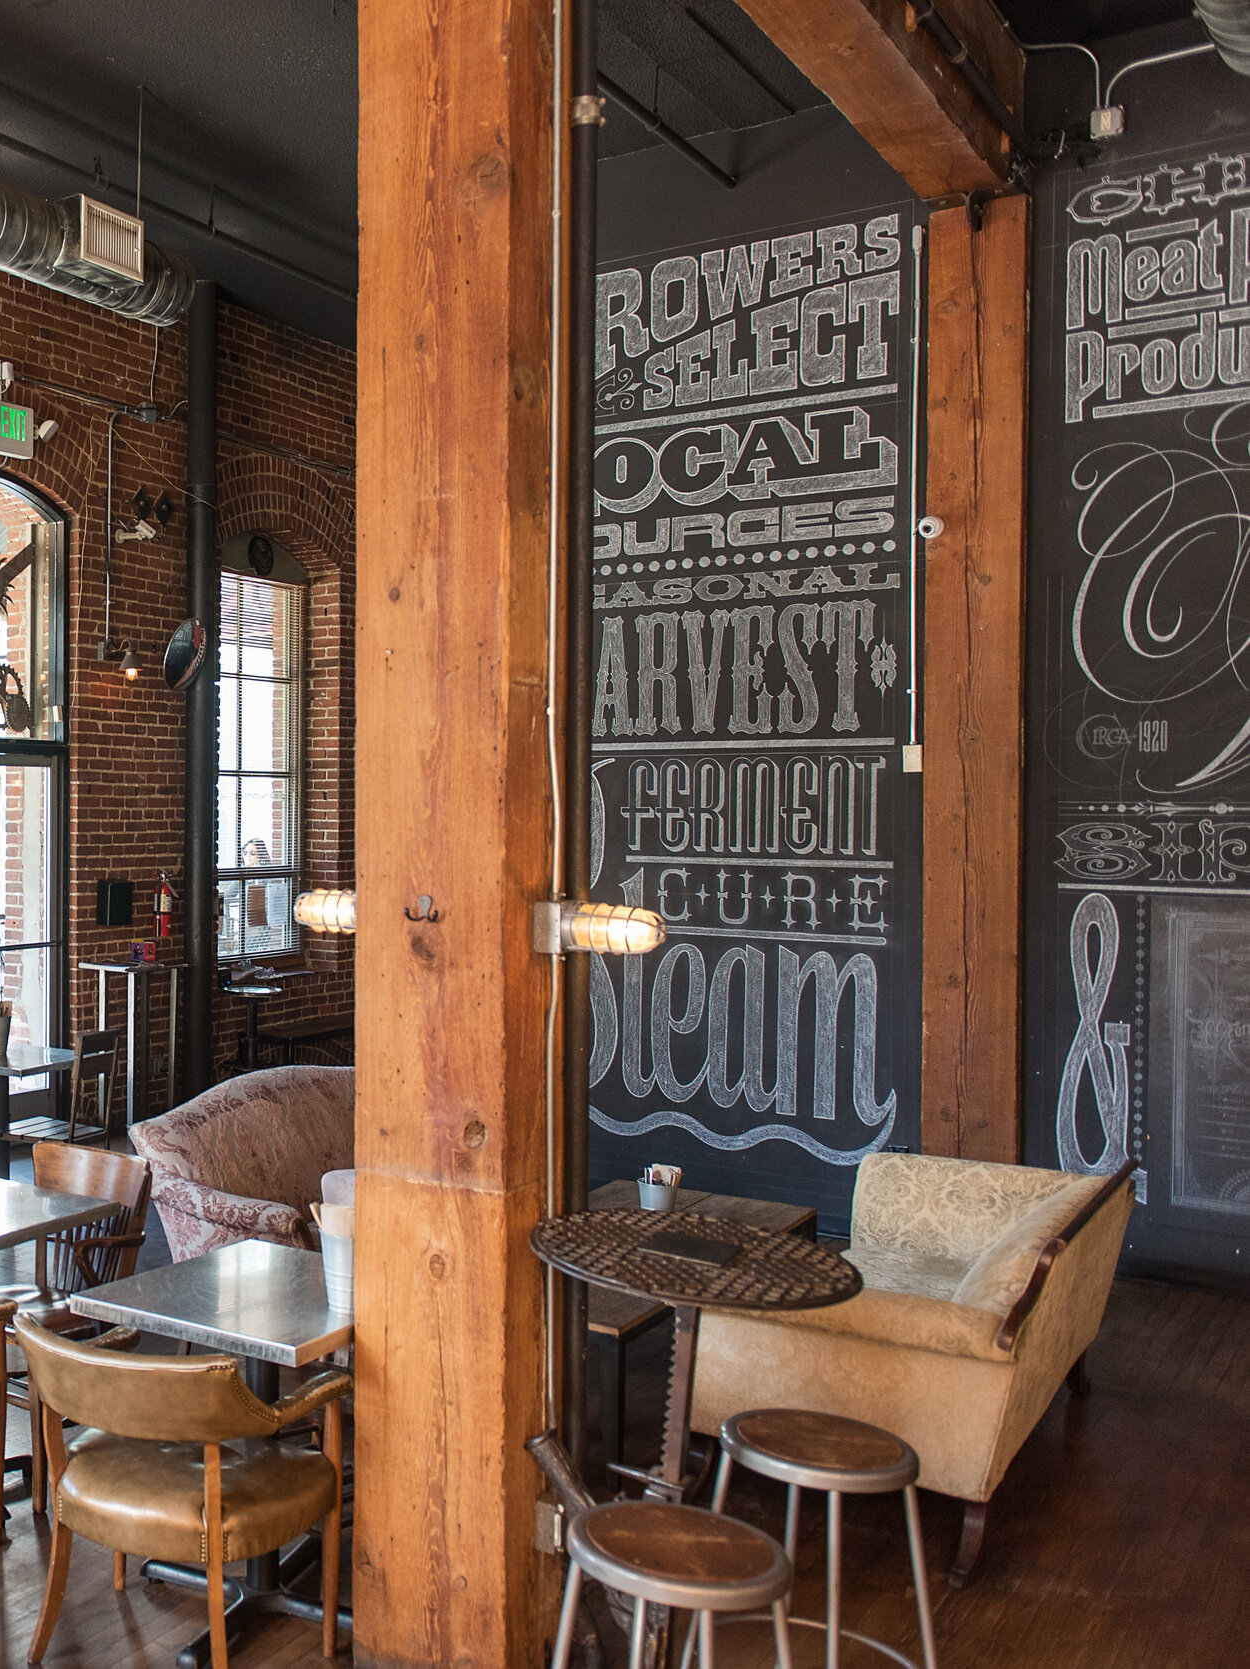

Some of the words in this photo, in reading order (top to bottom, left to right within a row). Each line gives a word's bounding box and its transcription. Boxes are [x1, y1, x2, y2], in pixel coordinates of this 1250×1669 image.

[1066, 218, 1223, 330] Meat
[643, 269, 901, 411] SELECT
[0, 405, 27, 442] EXIT
[593, 406, 899, 516] OCAL
[1138, 720, 1168, 752] 1920
[620, 755, 886, 855] FERMENT
[657, 867, 889, 932] CURE
